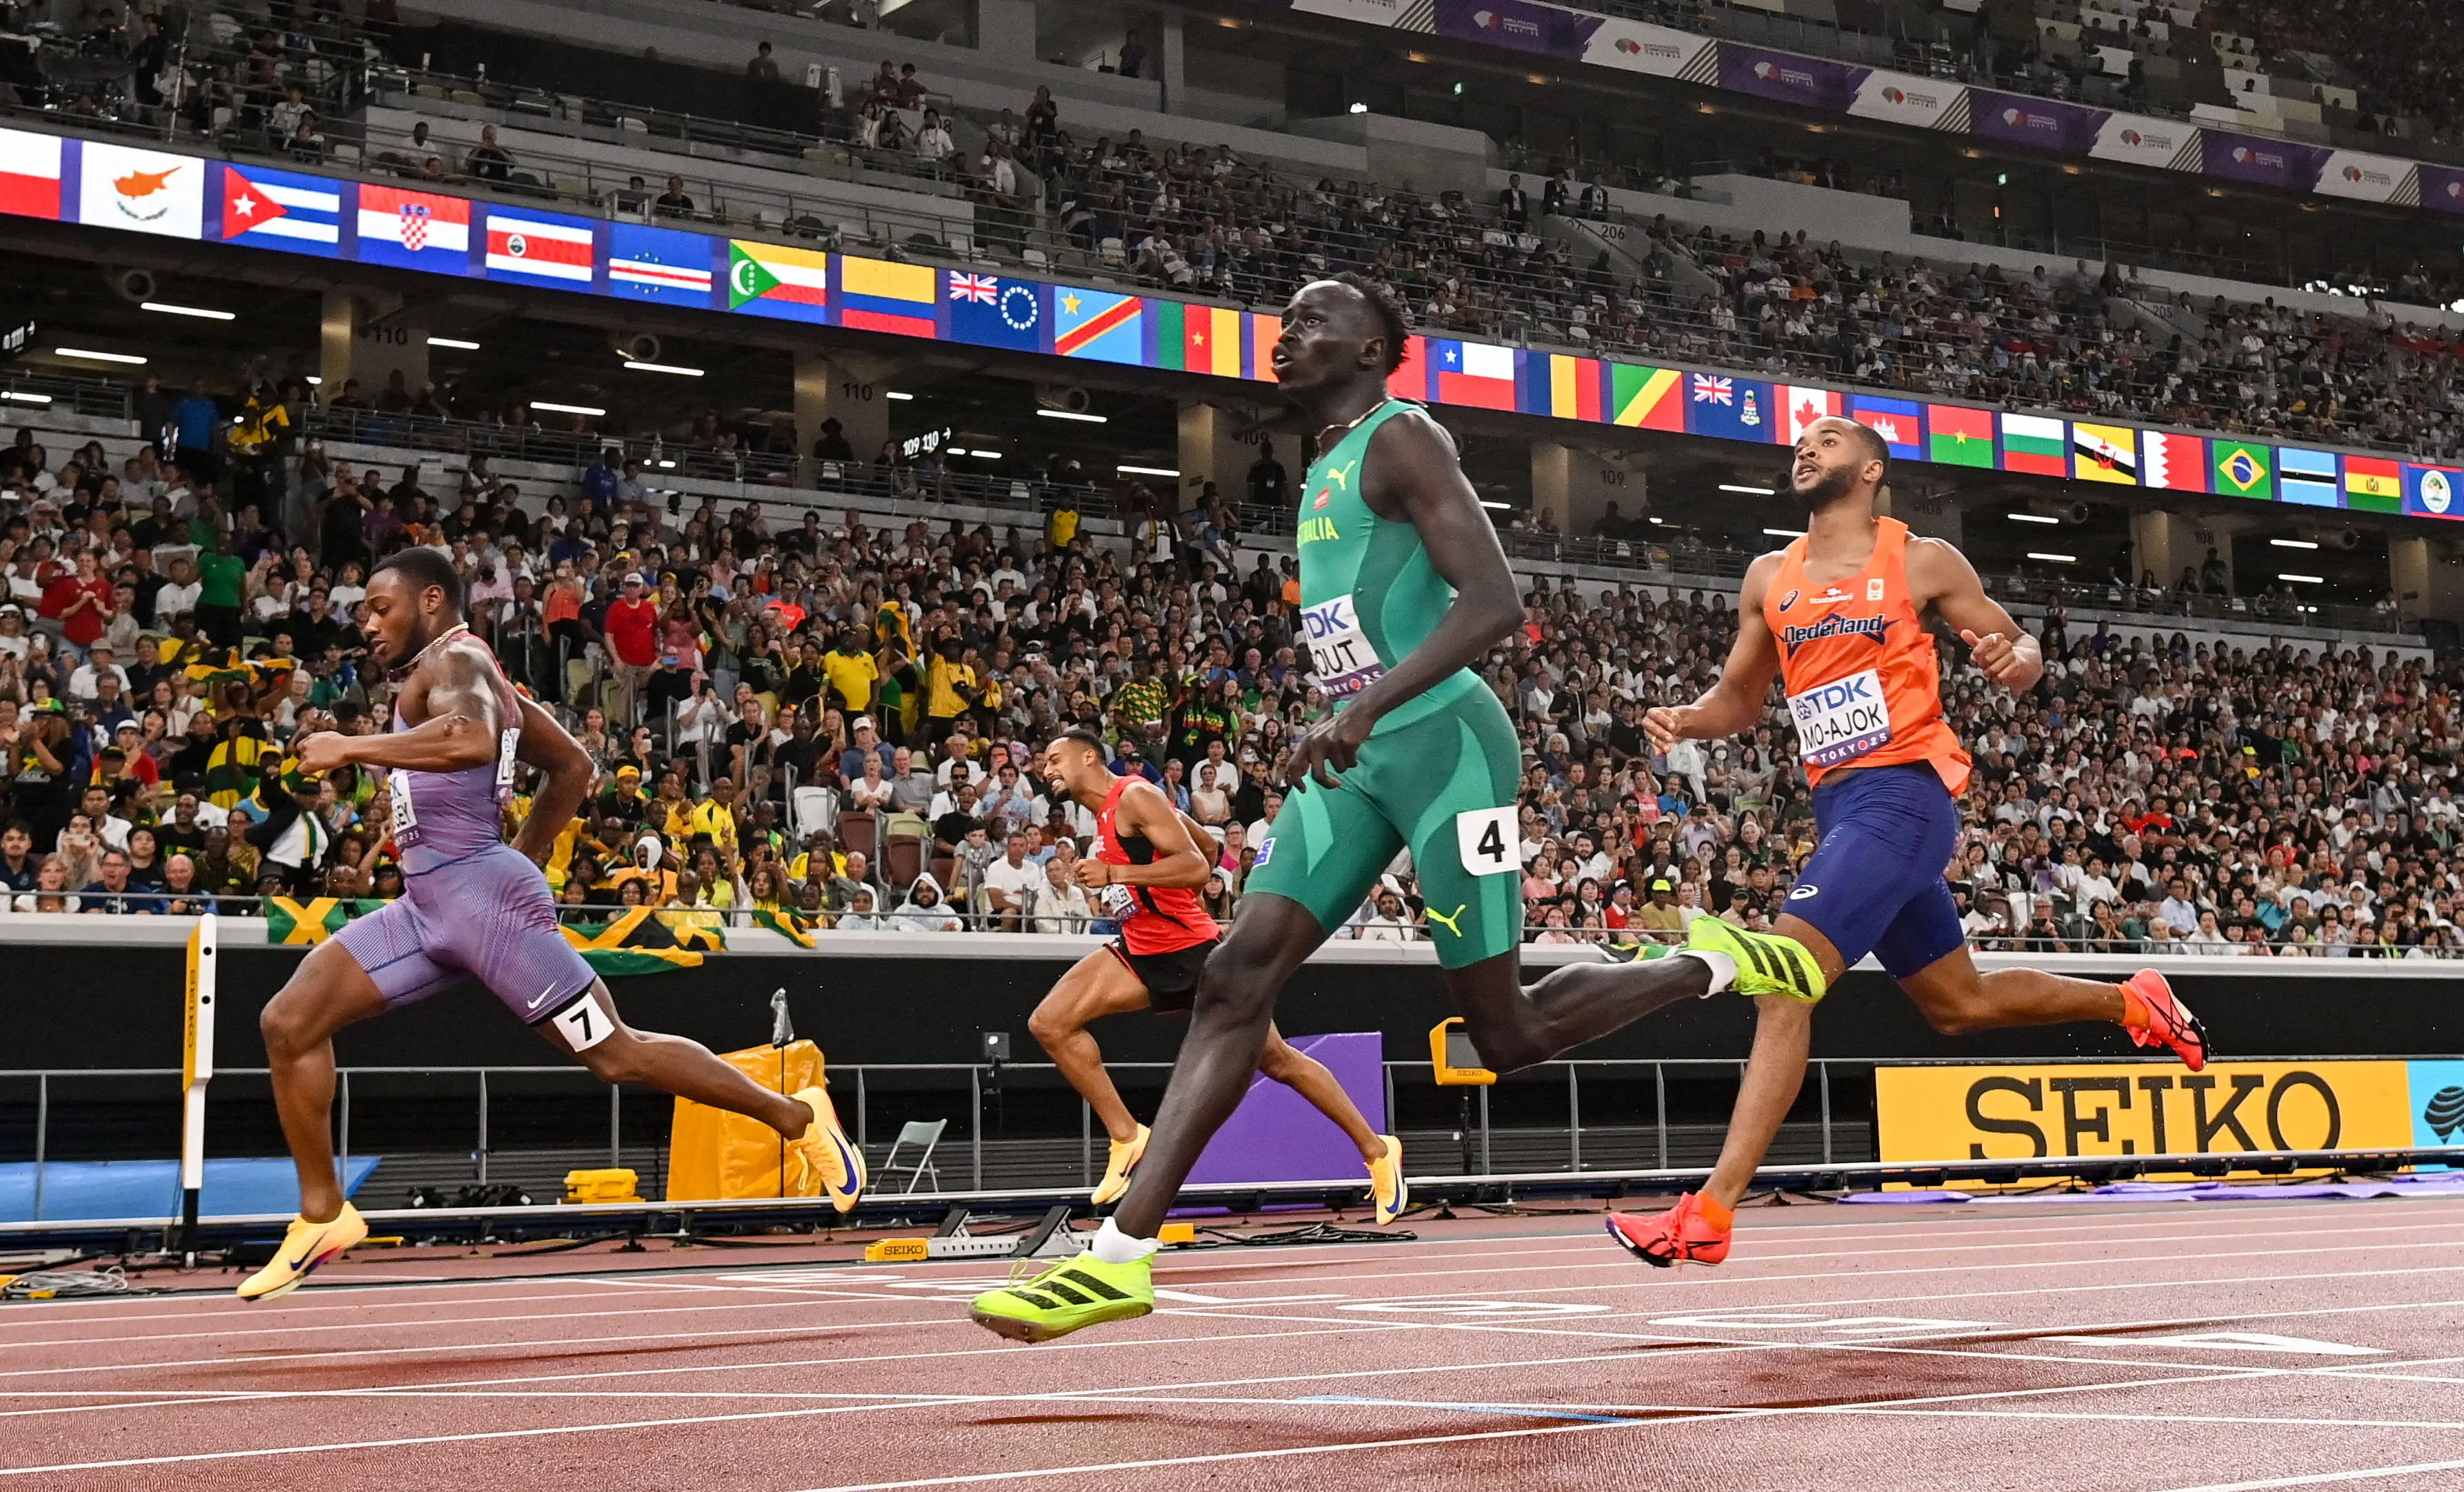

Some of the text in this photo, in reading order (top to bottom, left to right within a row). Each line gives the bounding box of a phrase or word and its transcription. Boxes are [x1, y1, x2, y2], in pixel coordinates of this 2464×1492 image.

[1601, 224, 1625, 240] 206
[372, 325, 408, 345] 110
[842, 383, 872, 401] 110
[903, 430, 939, 456] 109 110
[1600, 470, 1625, 485] 109
[1301, 602, 1350, 639] DK
[1313, 639, 1358, 676] OUT
[1805, 676, 1873, 714] TDK
[1802, 703, 1883, 751] MO-AJOK
[1477, 820, 1505, 863] 4
[568, 1007, 592, 1042] 7
[1965, 1071, 2341, 1161] SEIKO
[883, 1244, 924, 1256] SEIKO
